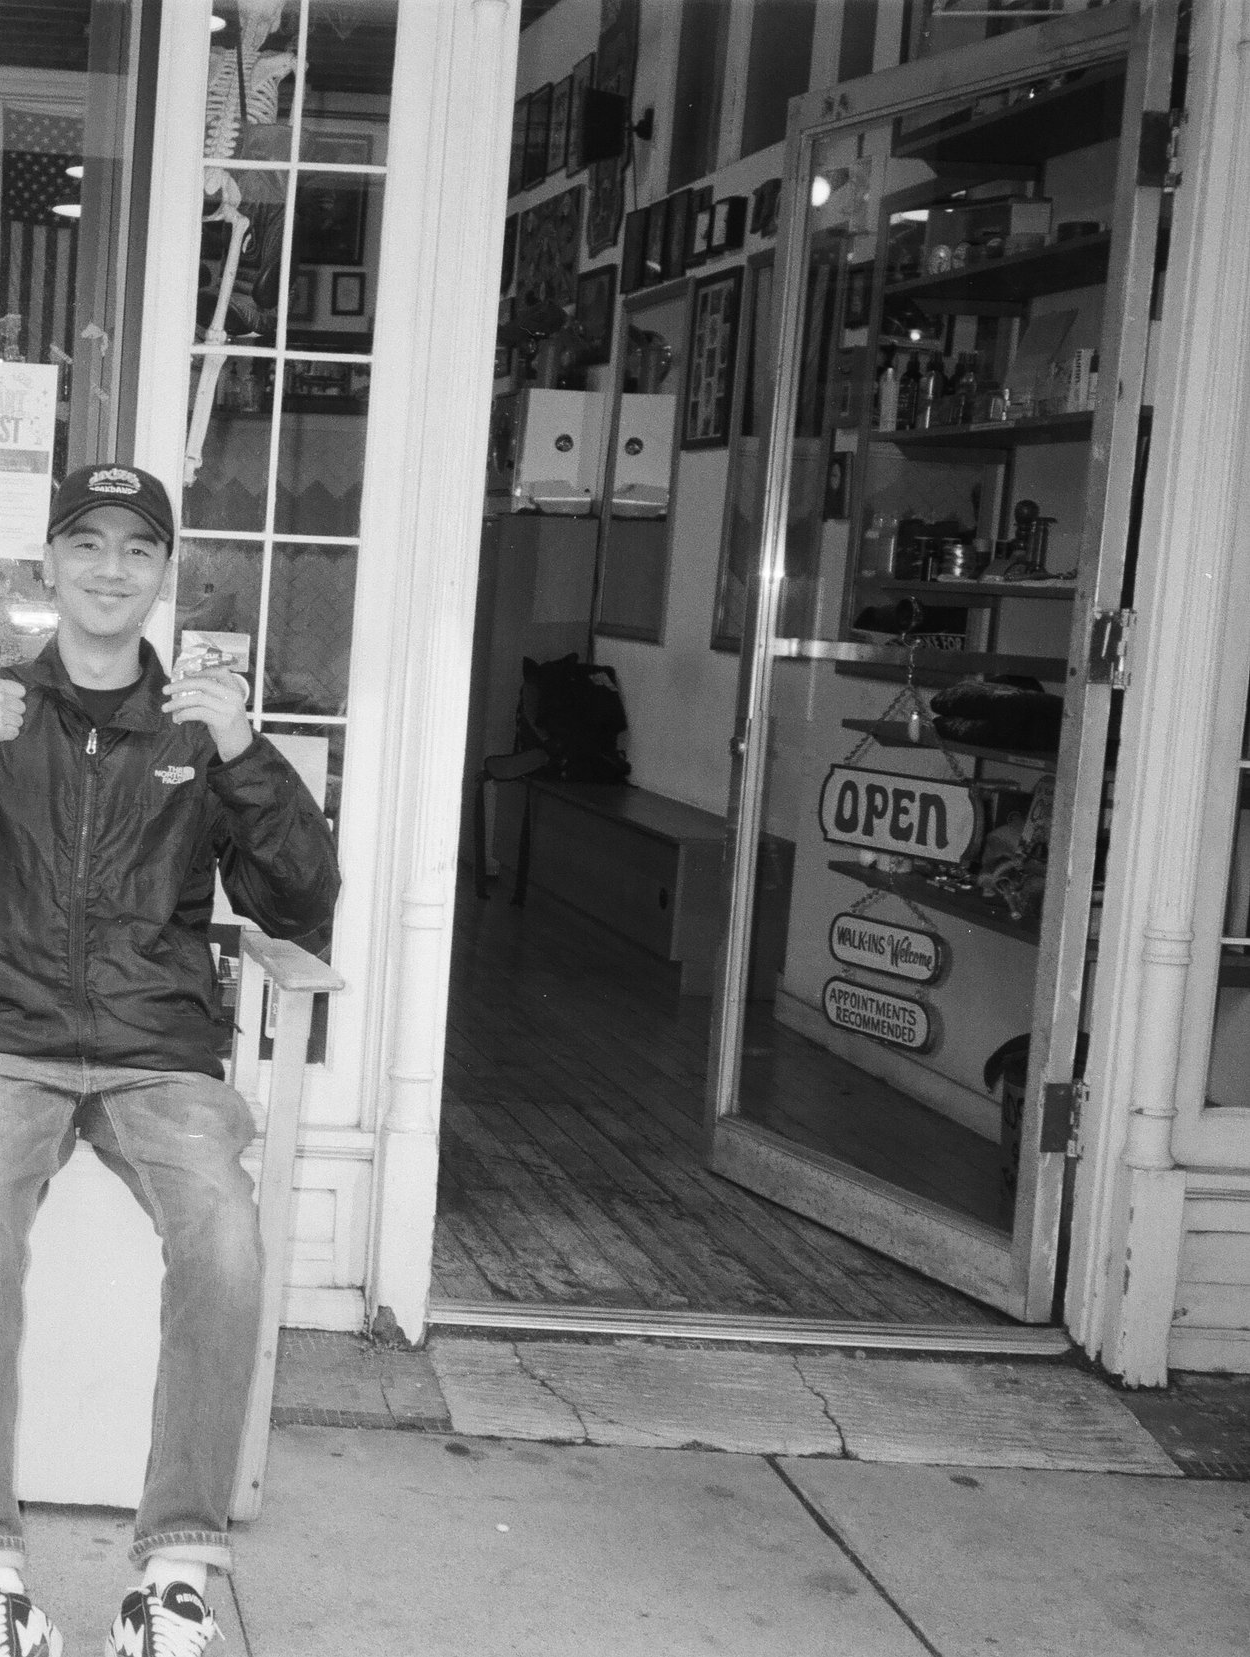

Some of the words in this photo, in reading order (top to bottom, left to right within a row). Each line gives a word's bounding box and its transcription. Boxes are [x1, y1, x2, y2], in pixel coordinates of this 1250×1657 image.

[154, 769, 183, 778] NORTH
[161, 776, 182, 785] FACE
[834, 779, 949, 850] OPEN
[836, 924, 886, 955] WALK-INS
[886, 934, 934, 972] Welcome
[829, 987, 917, 1027] APPOINTMENTS
[835, 1005, 916, 1044] RECOMMENDED
